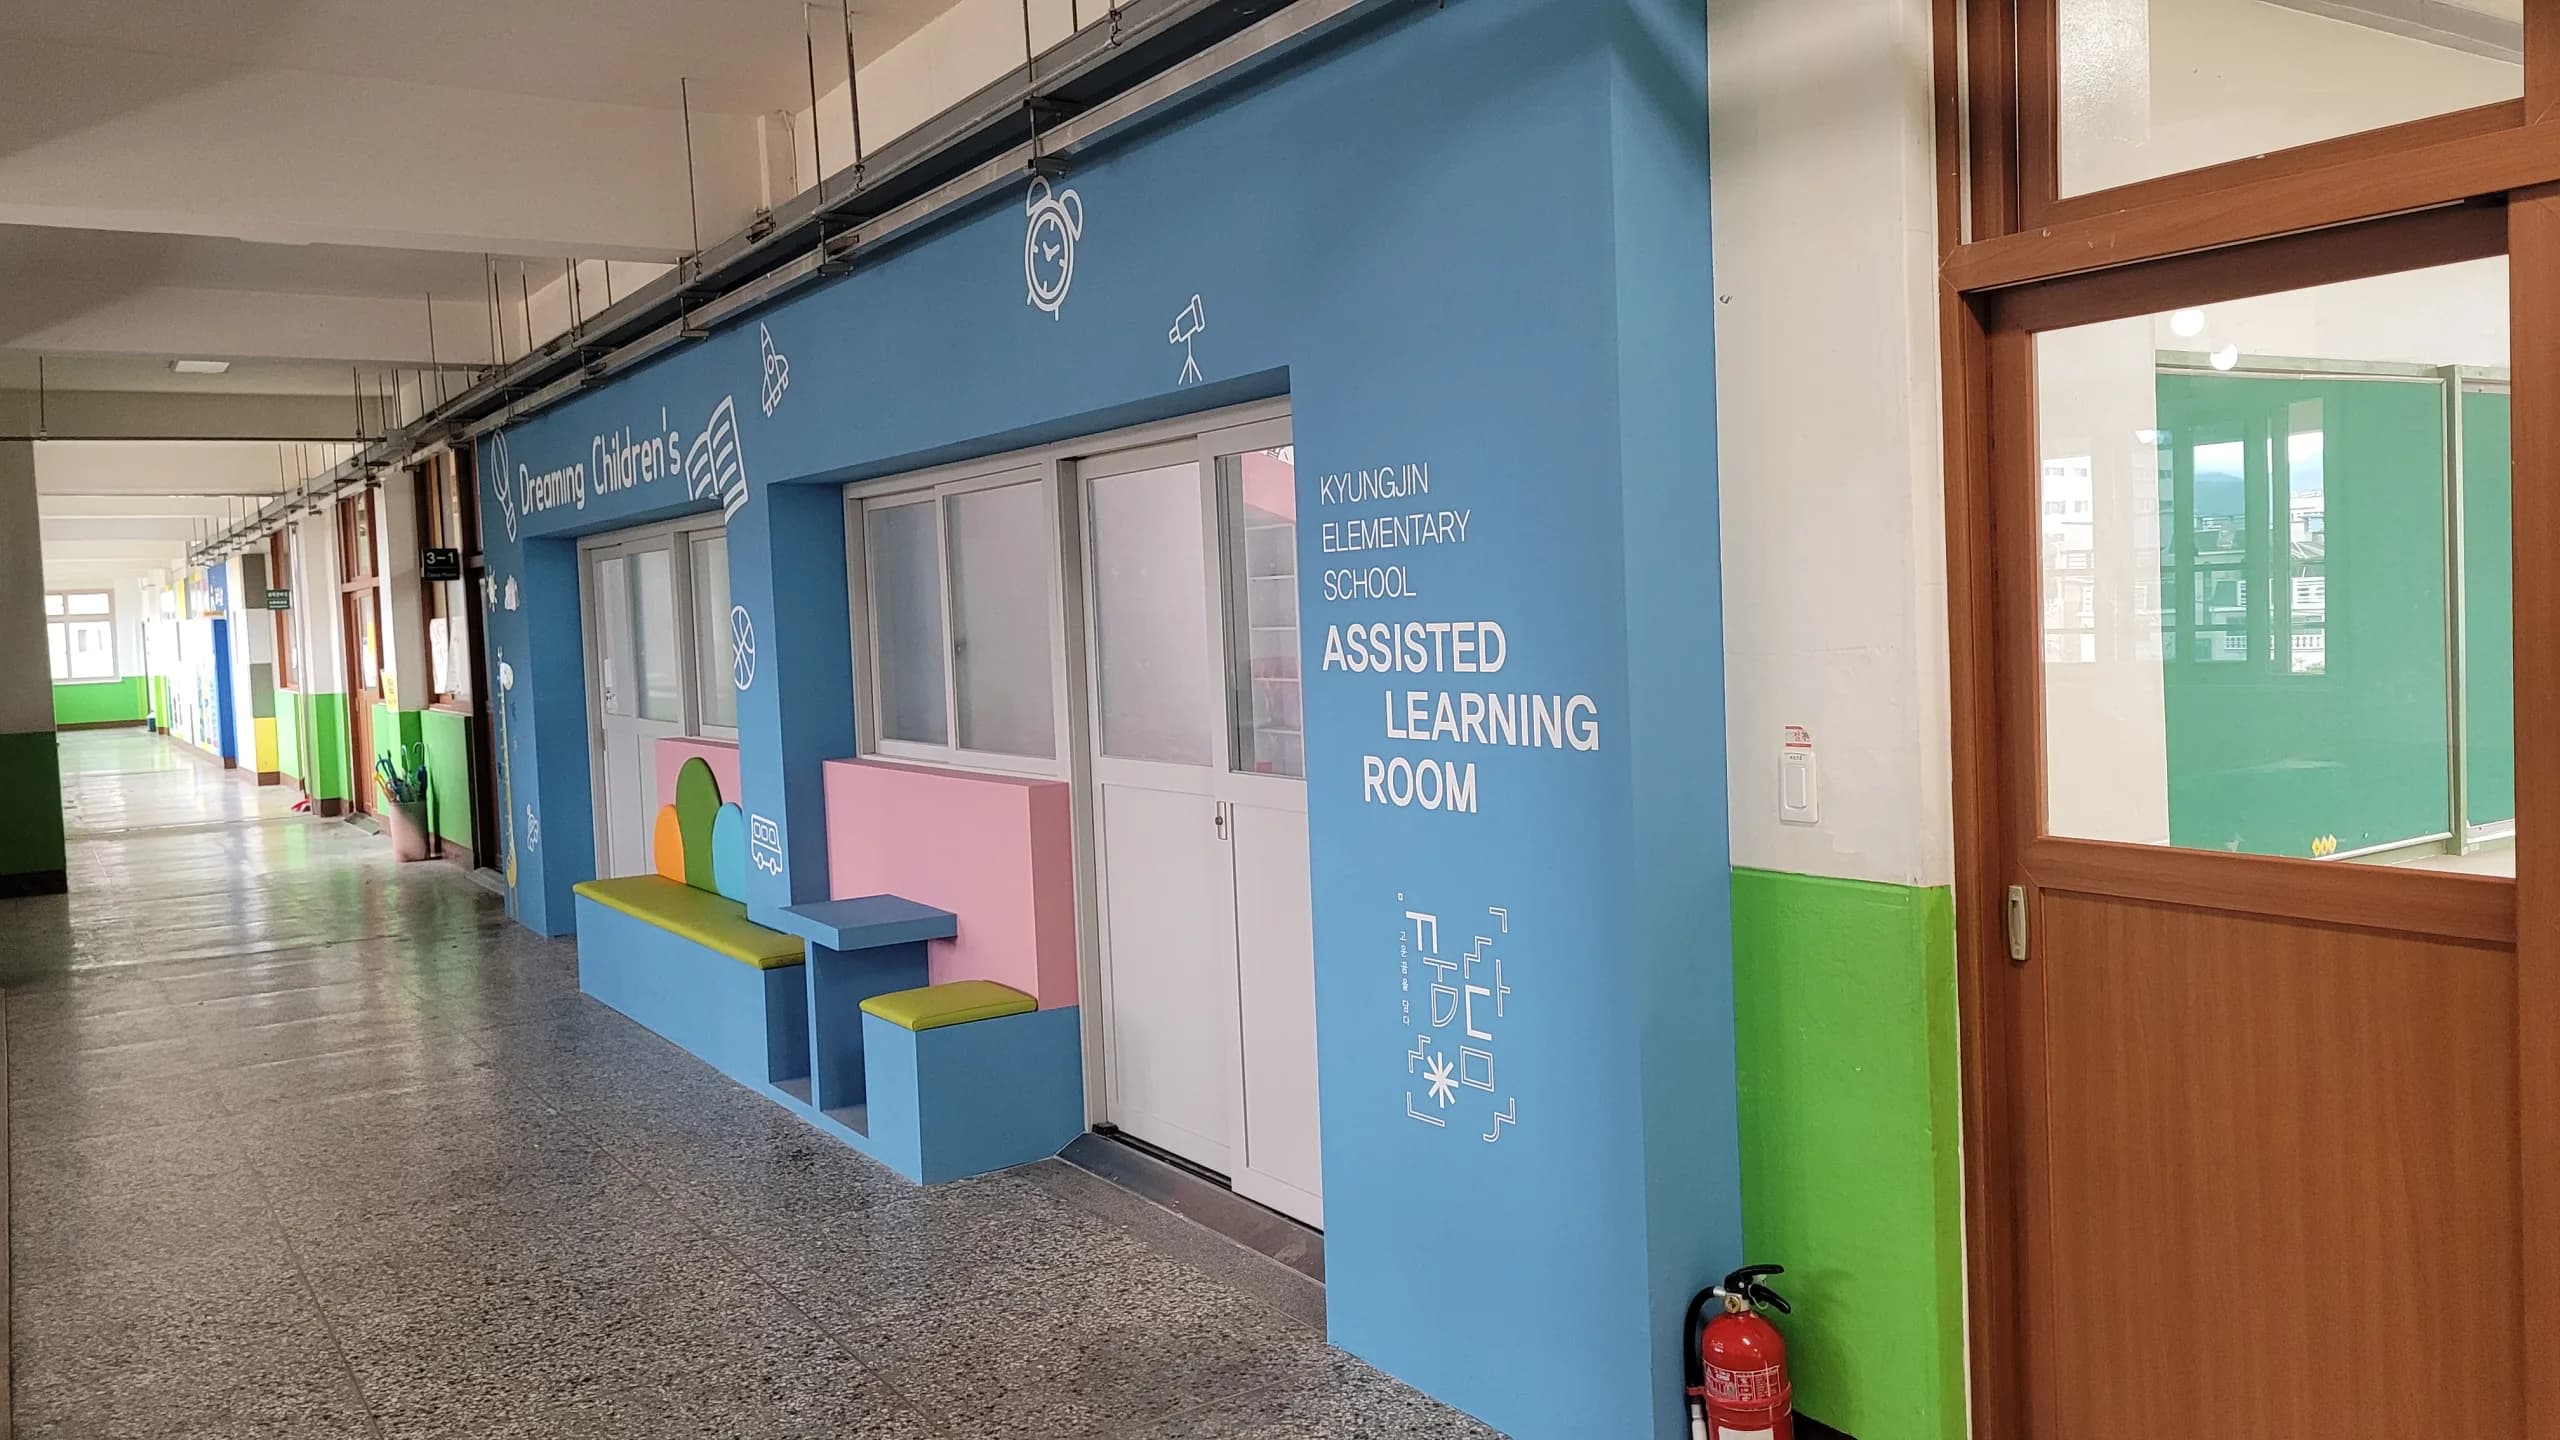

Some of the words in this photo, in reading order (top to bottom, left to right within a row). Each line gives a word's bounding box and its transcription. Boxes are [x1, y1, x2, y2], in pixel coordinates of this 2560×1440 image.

[519, 462, 584, 515] Dreaming
[592, 406, 681, 495] Children's
[1320, 462, 1429, 505] KYUNGJIN
[1322, 509, 1471, 552] ELEMENTARY
[426, 552, 454, 564] 3-1
[1323, 566, 1416, 601] SCHOOL
[1322, 621, 1507, 673] ASSISTED
[1385, 690, 1600, 751] LEARNING
[1363, 755, 1477, 813] ROOM
